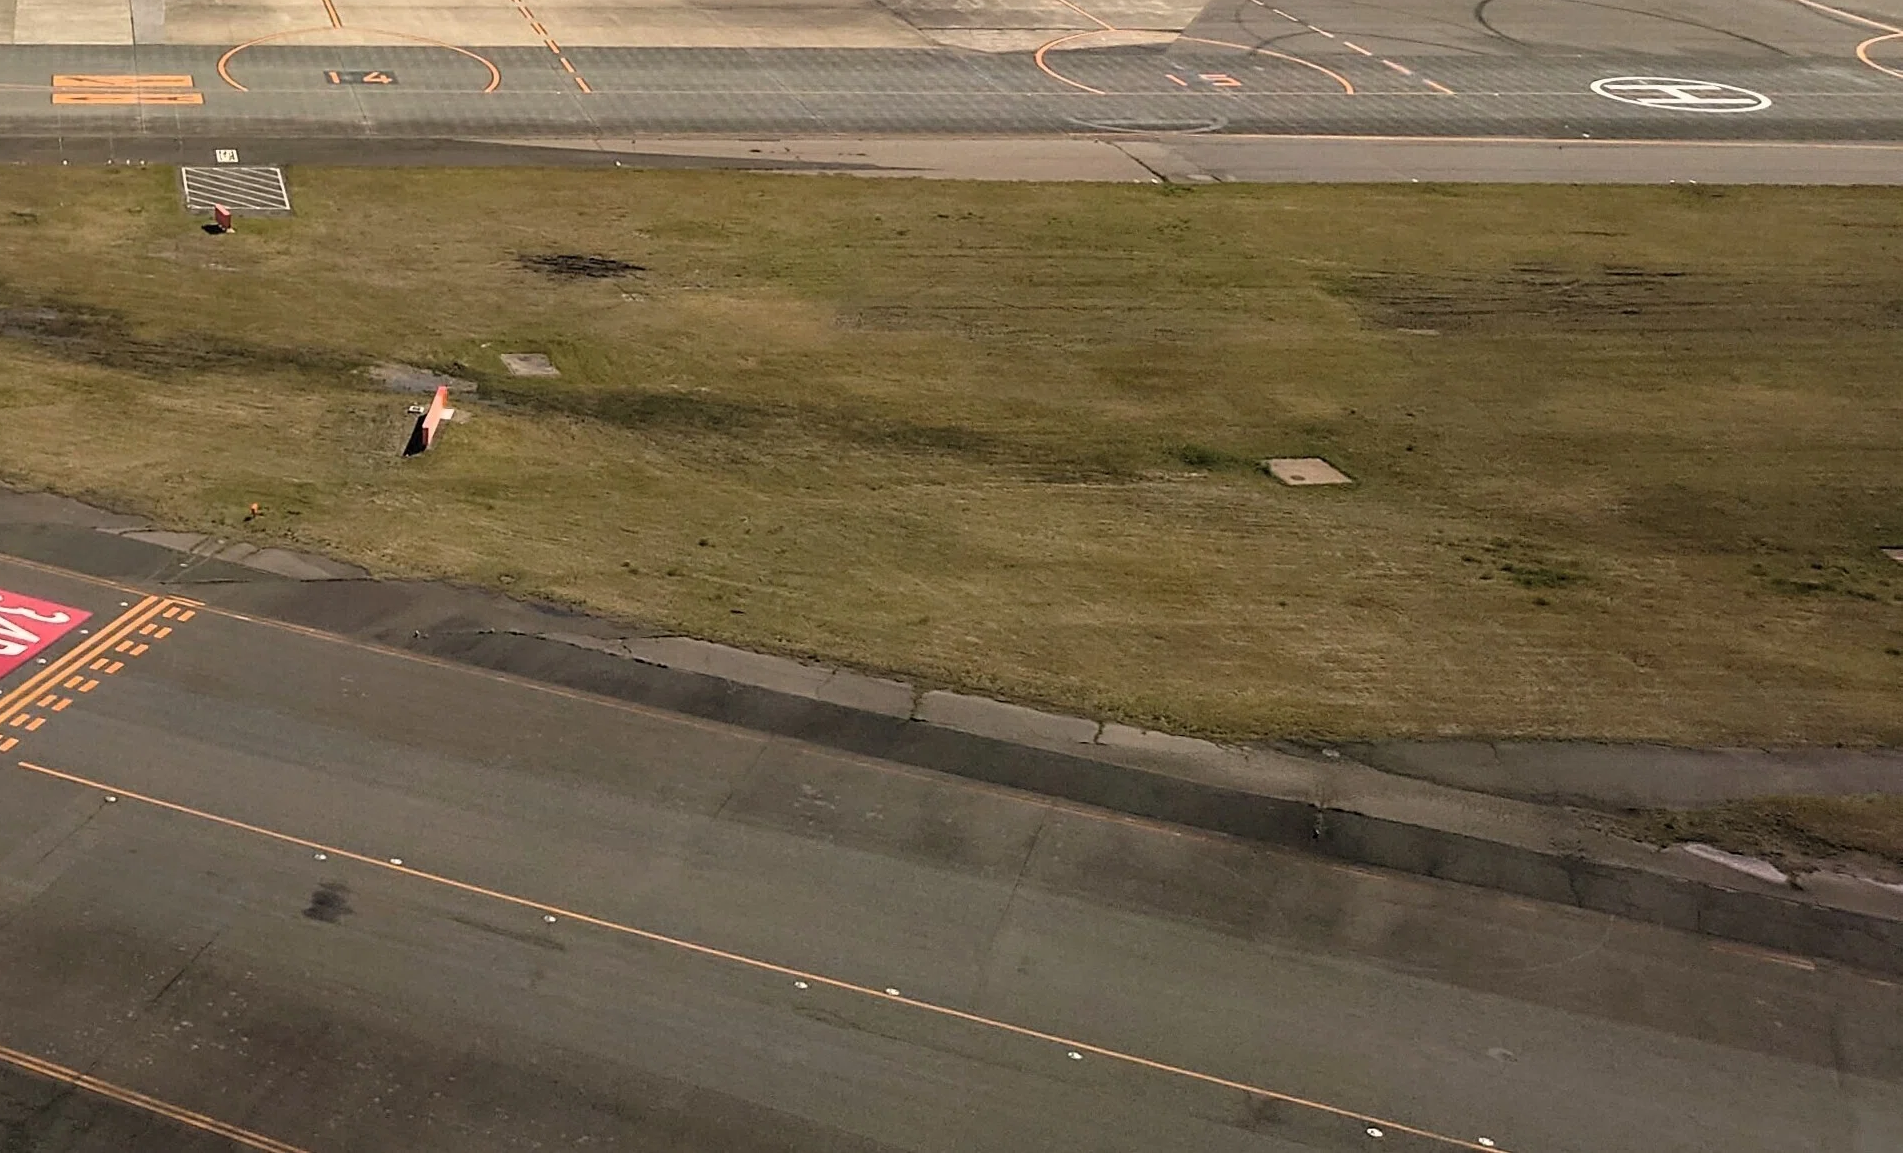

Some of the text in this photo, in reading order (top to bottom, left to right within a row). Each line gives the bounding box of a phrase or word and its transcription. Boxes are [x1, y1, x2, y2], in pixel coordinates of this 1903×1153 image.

[329, 71, 394, 85] 14
[1165, 74, 1244, 87] 15
[1603, 84, 1759, 104] H
